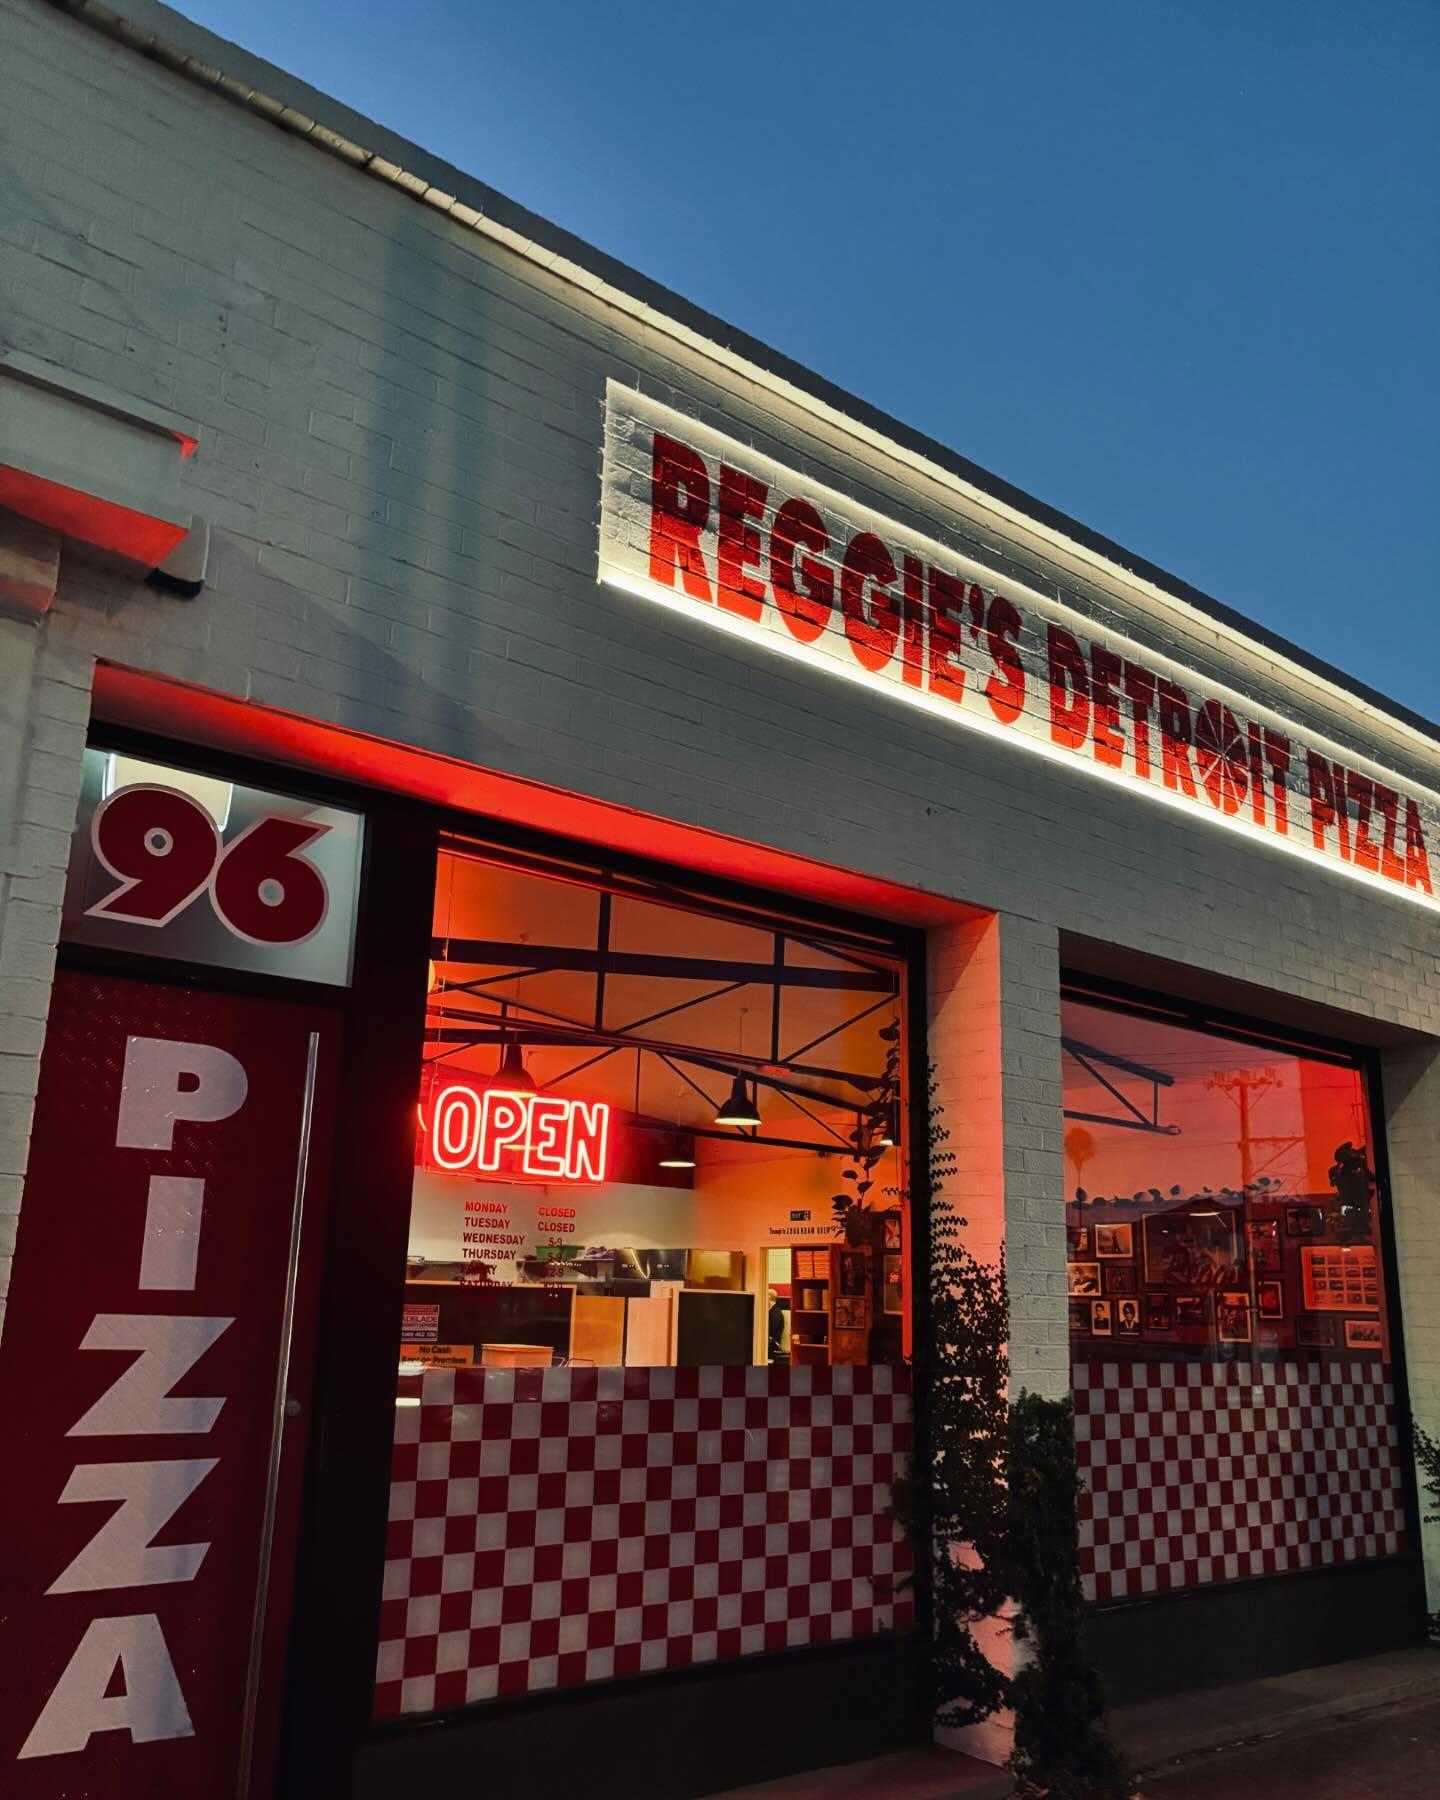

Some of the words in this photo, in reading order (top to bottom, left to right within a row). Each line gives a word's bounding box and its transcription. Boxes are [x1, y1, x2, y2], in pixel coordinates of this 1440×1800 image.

[648, 432, 1026, 725] REGGIE'S
[1047, 623, 1290, 836] DETROIT
[1306, 748, 1434, 896] PIZZA
[83, 782, 334, 948] 96
[432, 1085, 609, 1181] OPEN
[464, 1217, 510, 1229] TUESDAY
[538, 1221, 575, 1233] CLOSED
[465, 1201, 507, 1213] MONDAY
[539, 1207, 576, 1218] CLOSED
[462, 1248, 516, 1260] THURSDAY
[463, 1232, 525, 1246] WEDNESDAY
[16, 1035, 249, 1760] PIZZA
